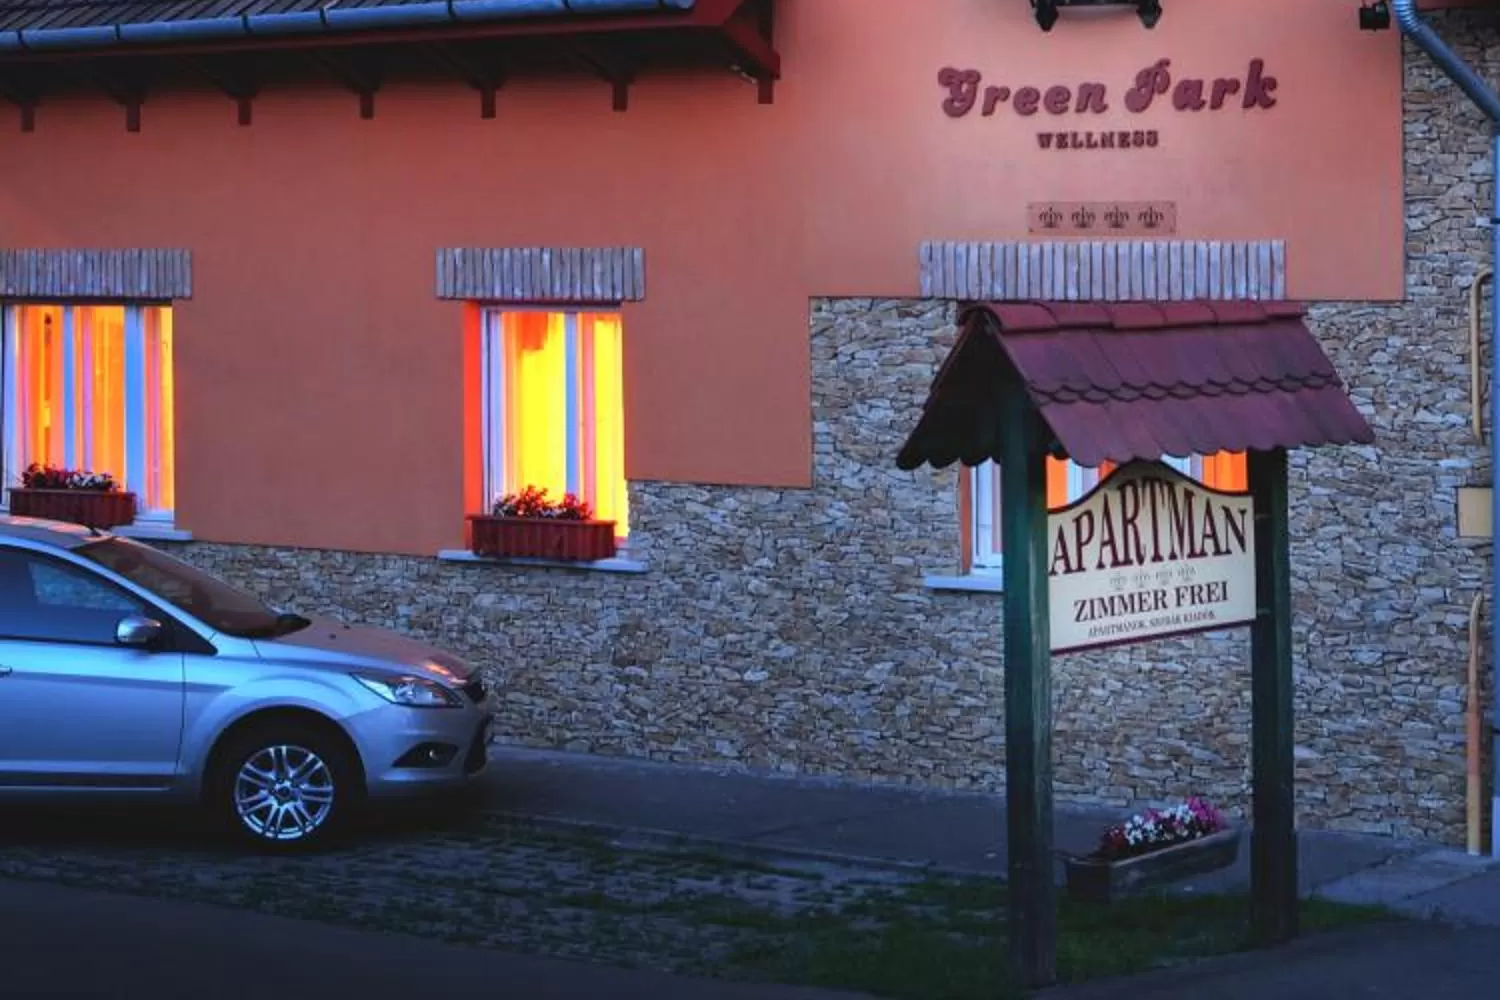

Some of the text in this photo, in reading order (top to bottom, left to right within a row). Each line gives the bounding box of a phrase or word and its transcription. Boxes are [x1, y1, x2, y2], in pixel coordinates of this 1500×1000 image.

[937, 57, 1279, 119] Green Park
[1036, 130, 1160, 150] WELLNESS
[1049, 477, 1247, 576] APARTMAN
[1073, 581, 1229, 623] ZIMMER FREI
